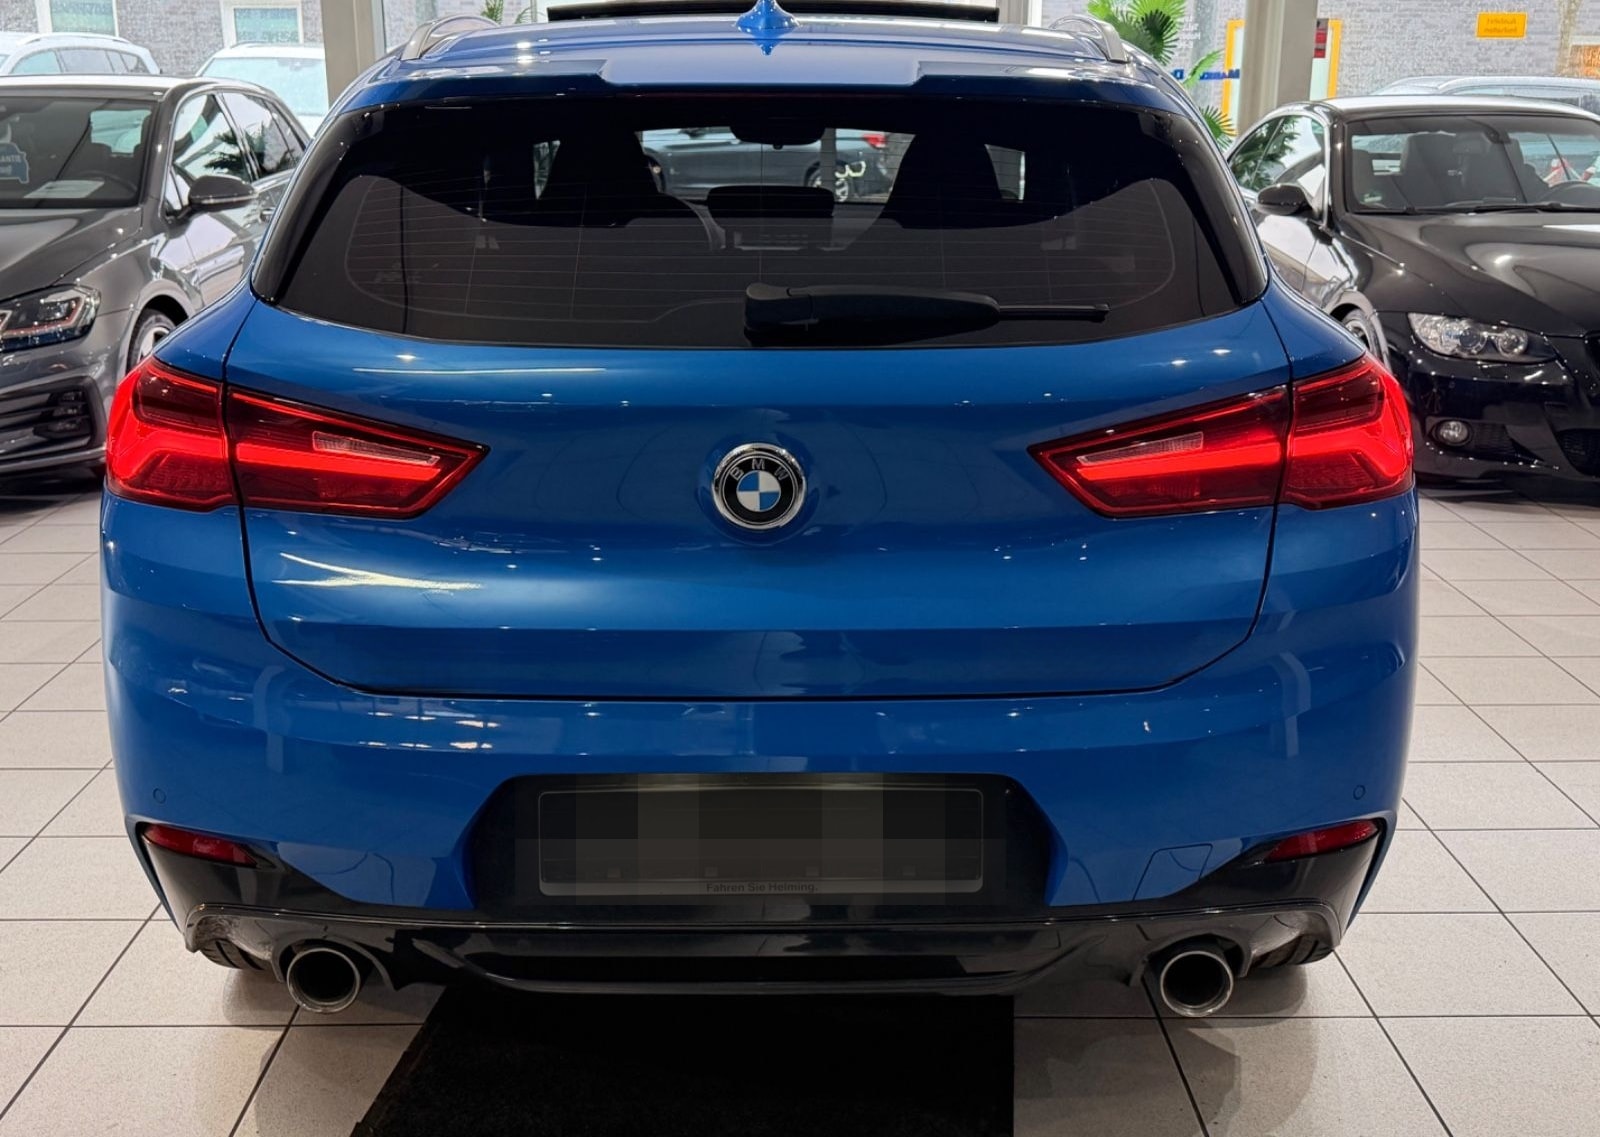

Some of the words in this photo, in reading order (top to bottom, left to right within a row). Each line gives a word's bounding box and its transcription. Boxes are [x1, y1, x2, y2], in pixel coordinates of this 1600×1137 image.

[729, 458, 789, 481] BMW
[706, 883, 745, 892] Fahren
[748, 882, 766, 892] Sie
